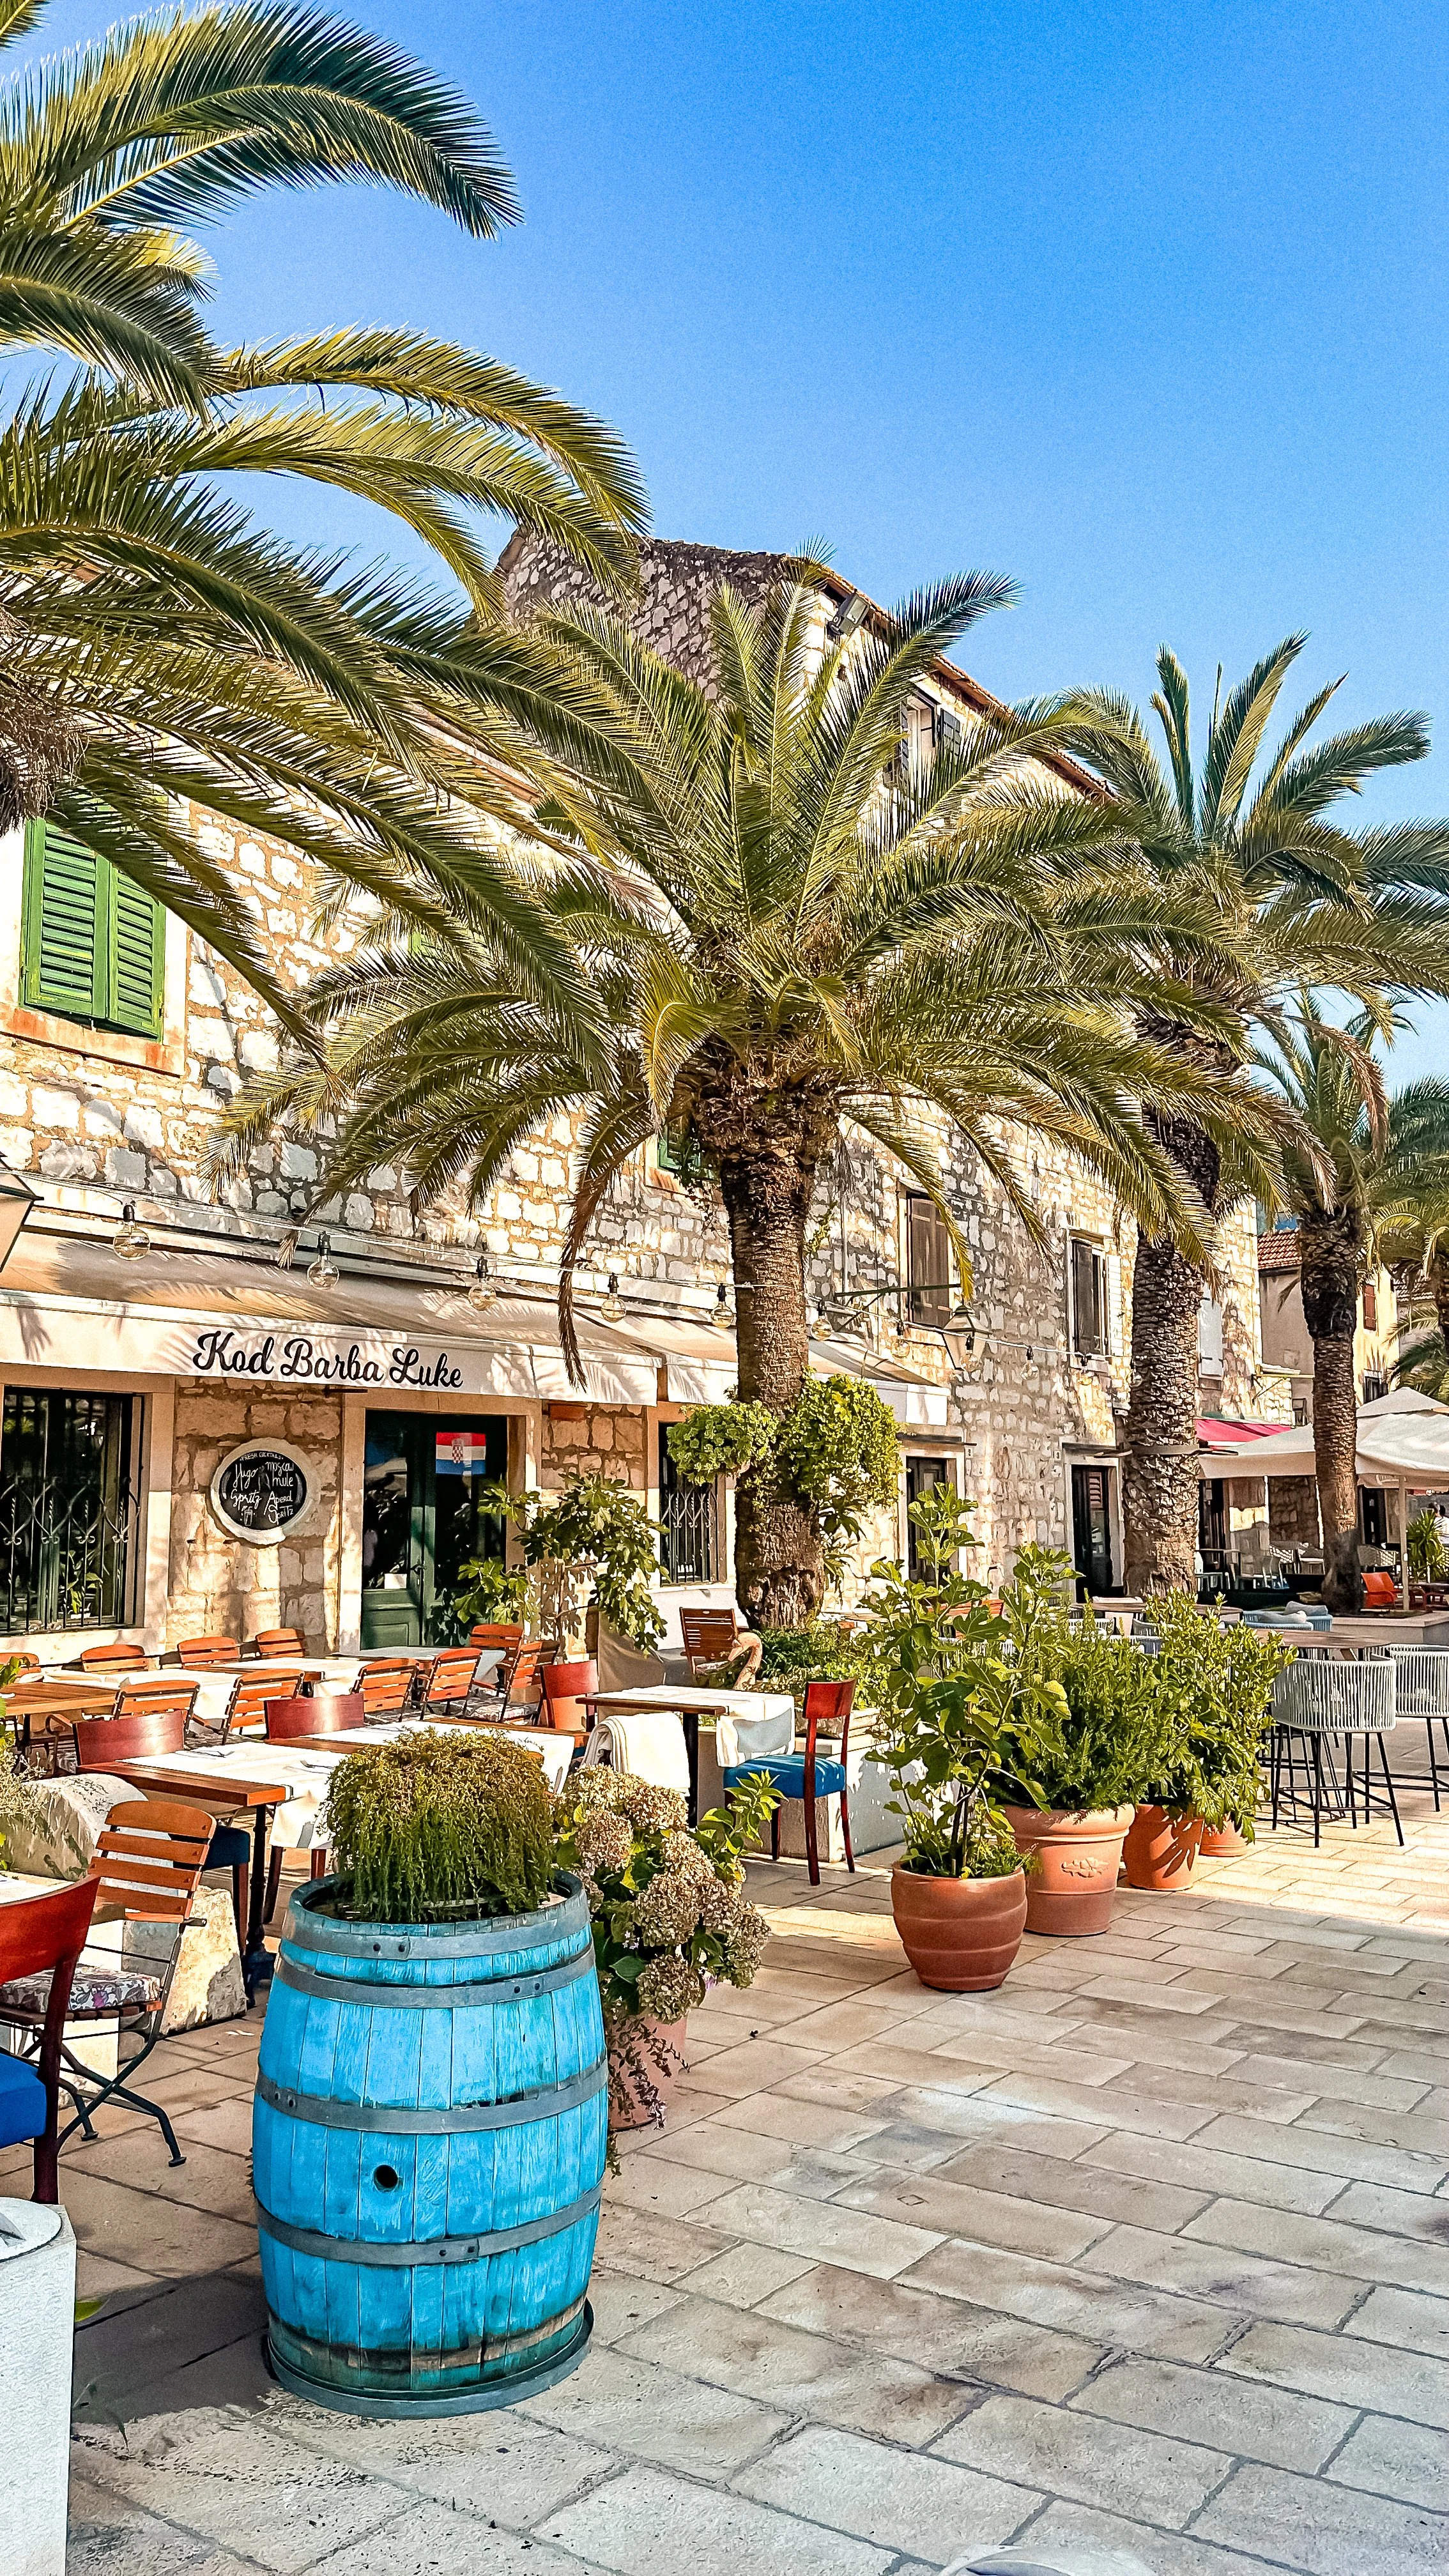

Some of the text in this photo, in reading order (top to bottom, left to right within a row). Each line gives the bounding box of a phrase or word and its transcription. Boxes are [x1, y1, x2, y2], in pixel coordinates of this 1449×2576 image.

[192, 1330, 464, 1388] Kod Barba Luke
[233, 1462, 259, 1491] Hugo
[230, 1489, 262, 1511] Spritz
